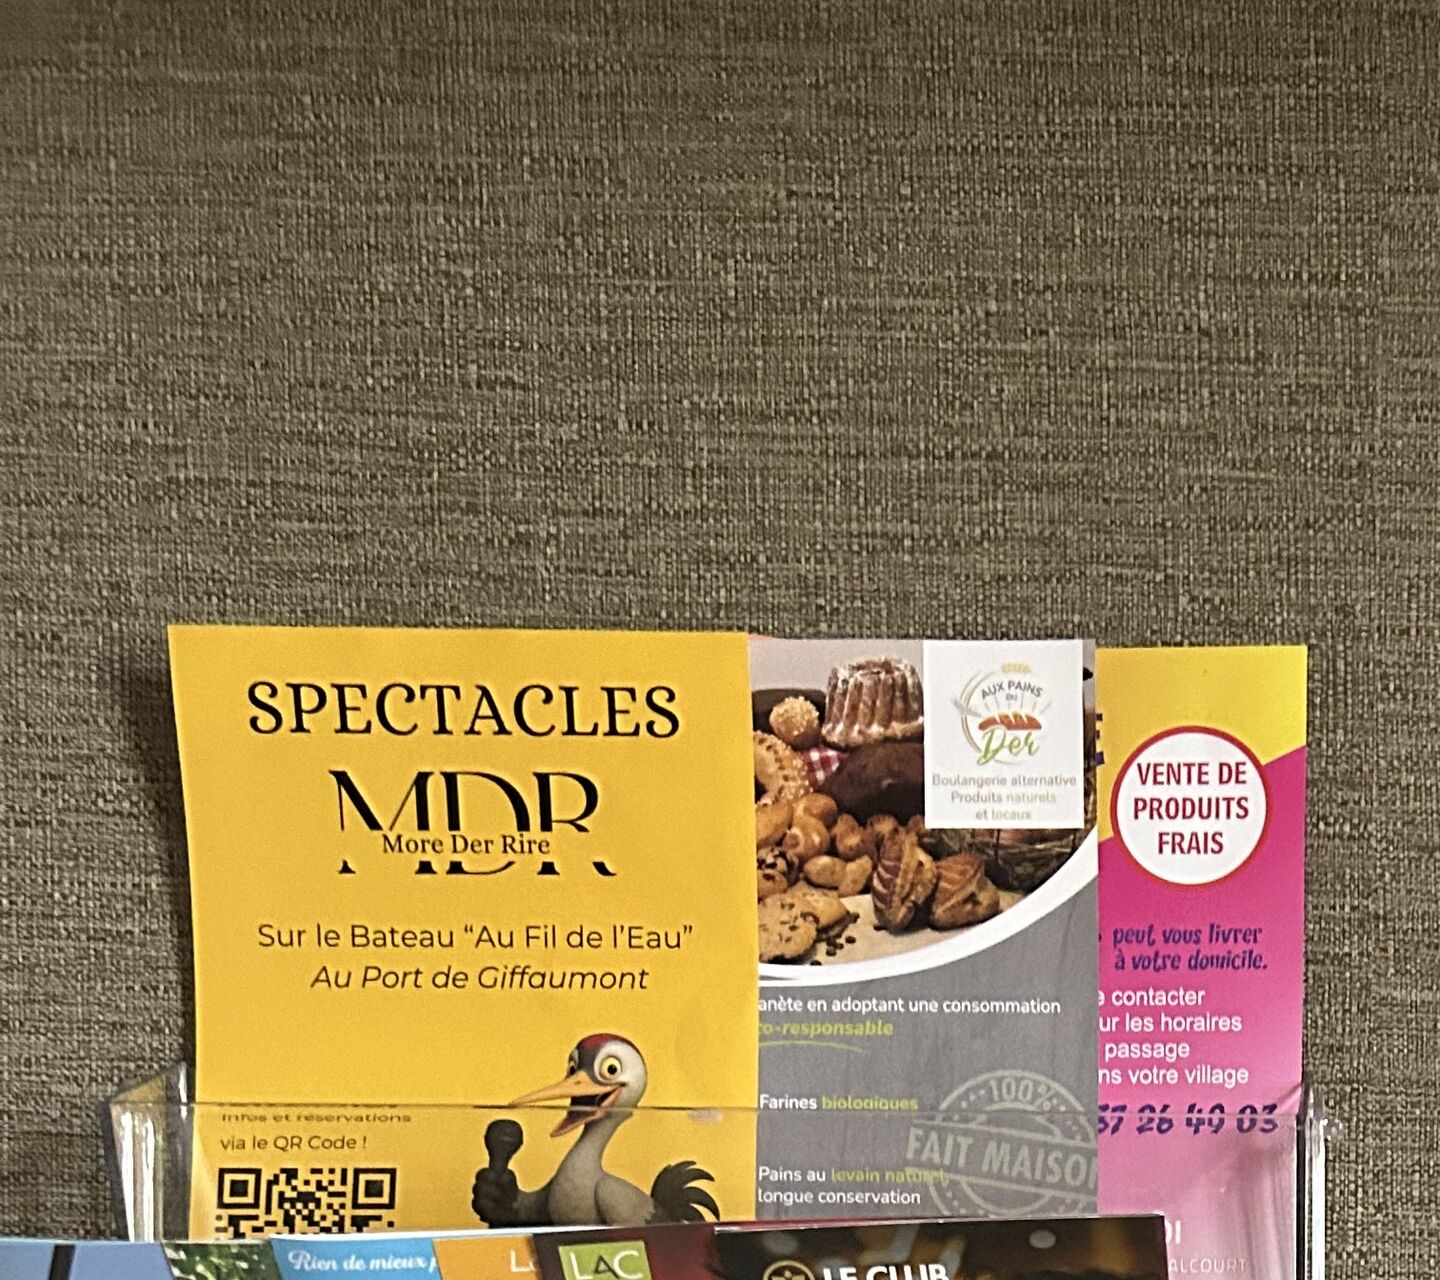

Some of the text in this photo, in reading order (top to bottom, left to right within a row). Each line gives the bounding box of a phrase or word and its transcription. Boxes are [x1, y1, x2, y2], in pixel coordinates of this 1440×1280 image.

[1008, 680, 1043, 698] PAINS
[247, 680, 680, 738] SPECTACLES
[932, 774, 1077, 788] Boulangerie alternative
[1137, 761, 1247, 787] VENTE DE
[951, 791, 1003, 803] Produits
[1133, 796, 1249, 821] PRODUITS
[328, 769, 617, 876] MDR
[382, 833, 550, 855] More Der Rire
[1157, 830, 1224, 856] FRAIS
[257, 923, 603, 949] Sur le Bateau Fil de
[1112, 922, 1262, 949] peut vous livrer
[1115, 948, 1268, 972] à votre domicile.
[310, 964, 649, 991] Au Port de Giffaumont
[807, 997, 1061, 1015] en adoptant une consommation
[1111, 986, 1206, 1006] contacter
[1125, 1011, 1243, 1032] les horaires
[1104, 1041, 1191, 1063] passage
[1128, 1064, 1250, 1089] votre village
[759, 1095, 818, 1110] Farines
[220, 1135, 357, 1152] via le QR Code
[907, 1126, 974, 1168] FAIT
[759, 1167, 880, 1182] Pains au levain
[758, 1188, 921, 1206] longue conservation
[288, 1250, 428, 1271] Rien de mieux
[570, 1250, 643, 1280] LAC
